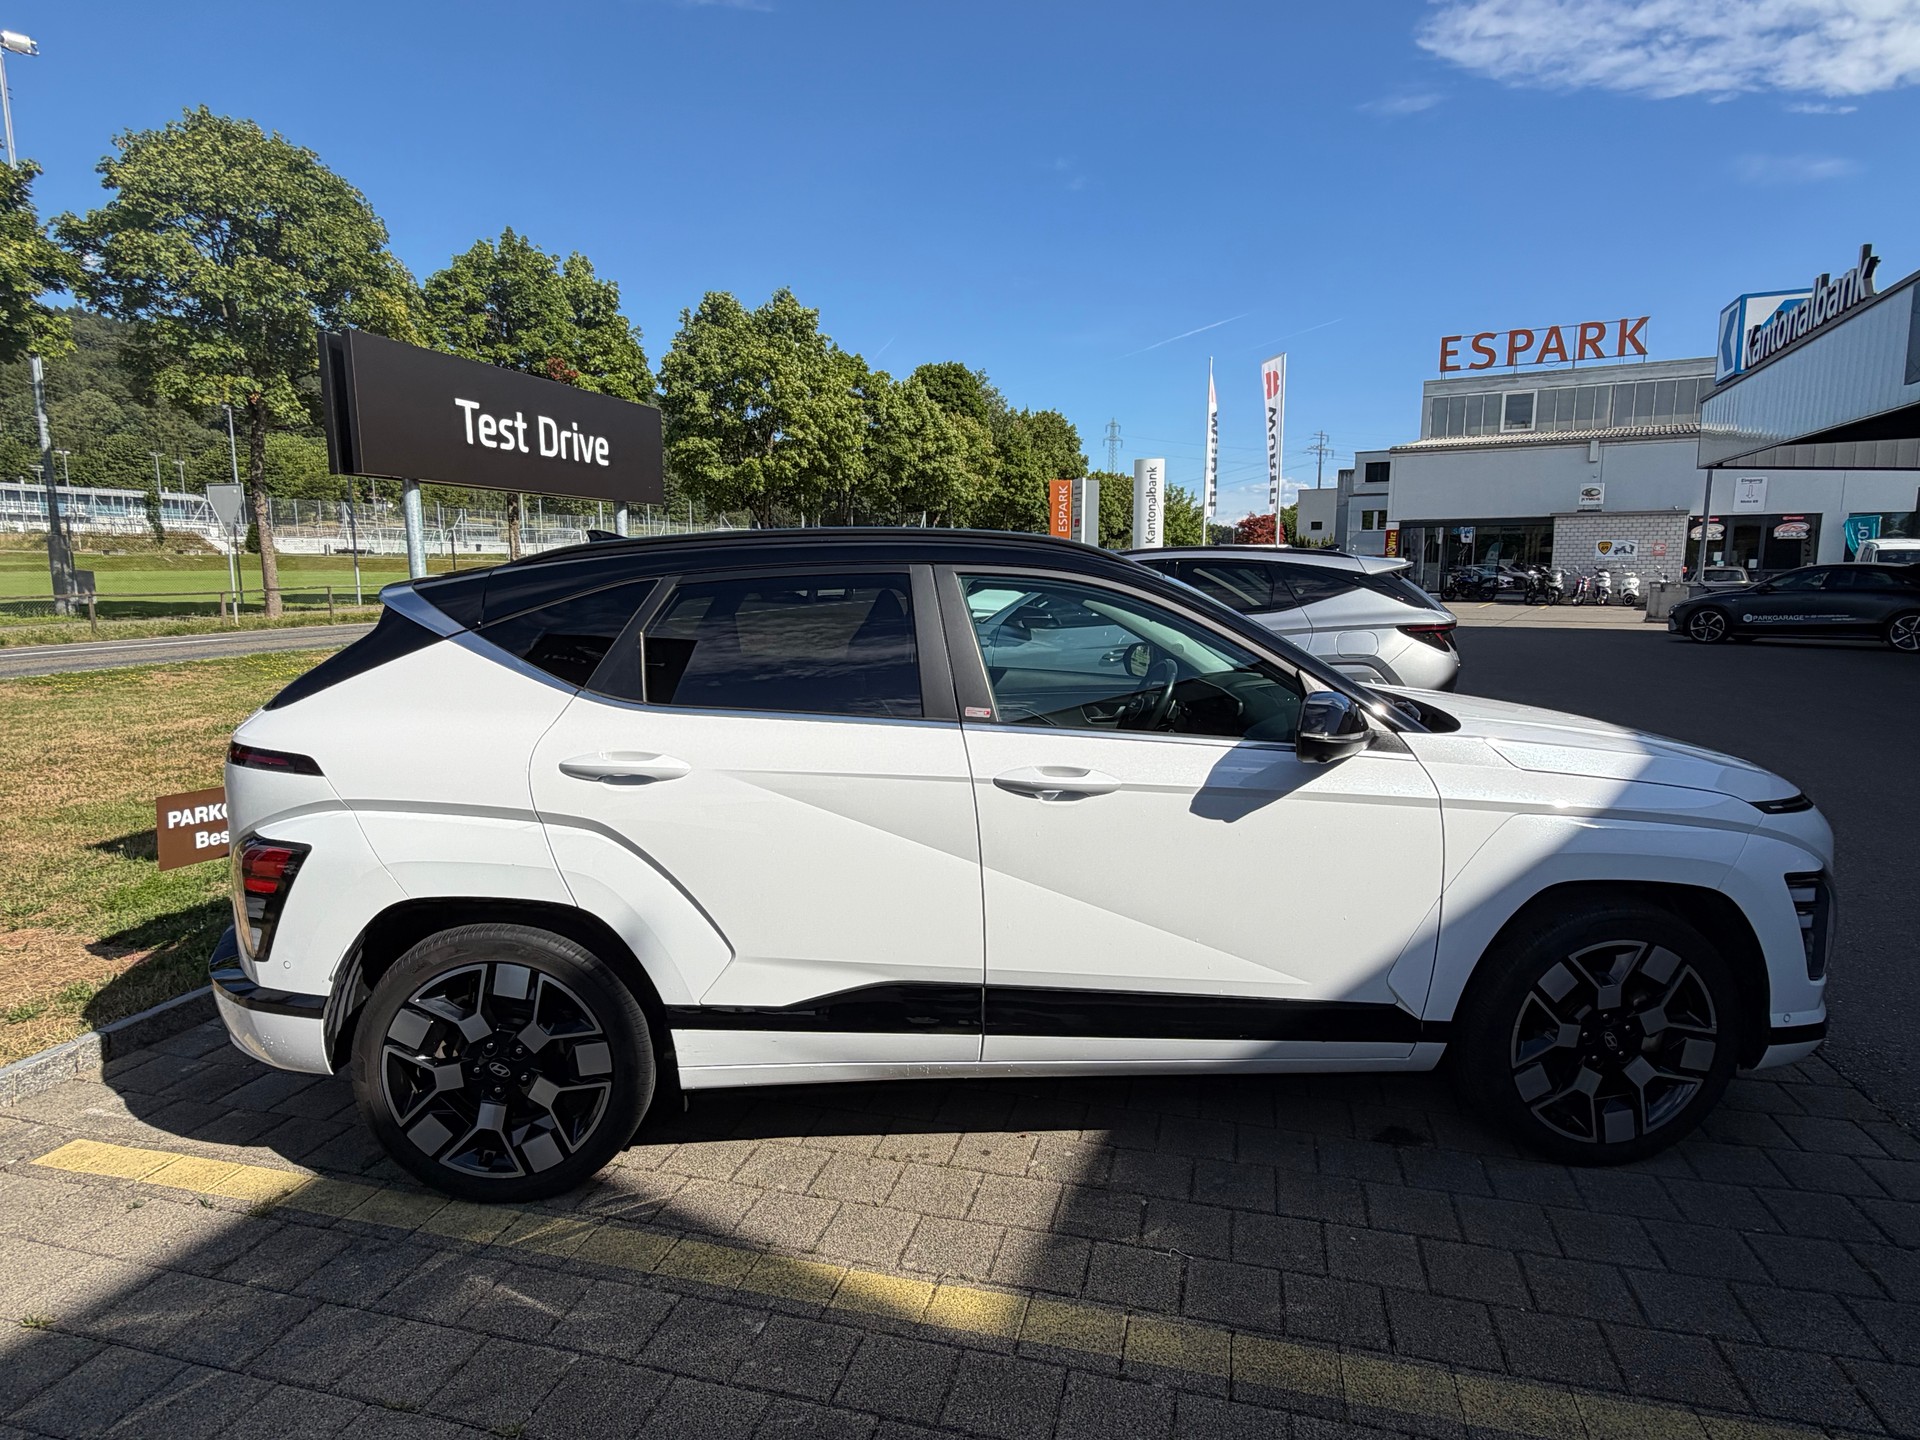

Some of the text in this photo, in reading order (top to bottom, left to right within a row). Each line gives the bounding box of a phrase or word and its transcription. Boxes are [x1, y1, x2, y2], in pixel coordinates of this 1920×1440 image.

[1745, 243, 1881, 369] Kantonalbank
[1439, 316, 1651, 372] ESPARK
[454, 397, 610, 467] Test Drive
[1058, 485, 1068, 532] ESPARK
[1145, 466, 1158, 544] Kantonalbank
[195, 830, 230, 849] Bes
